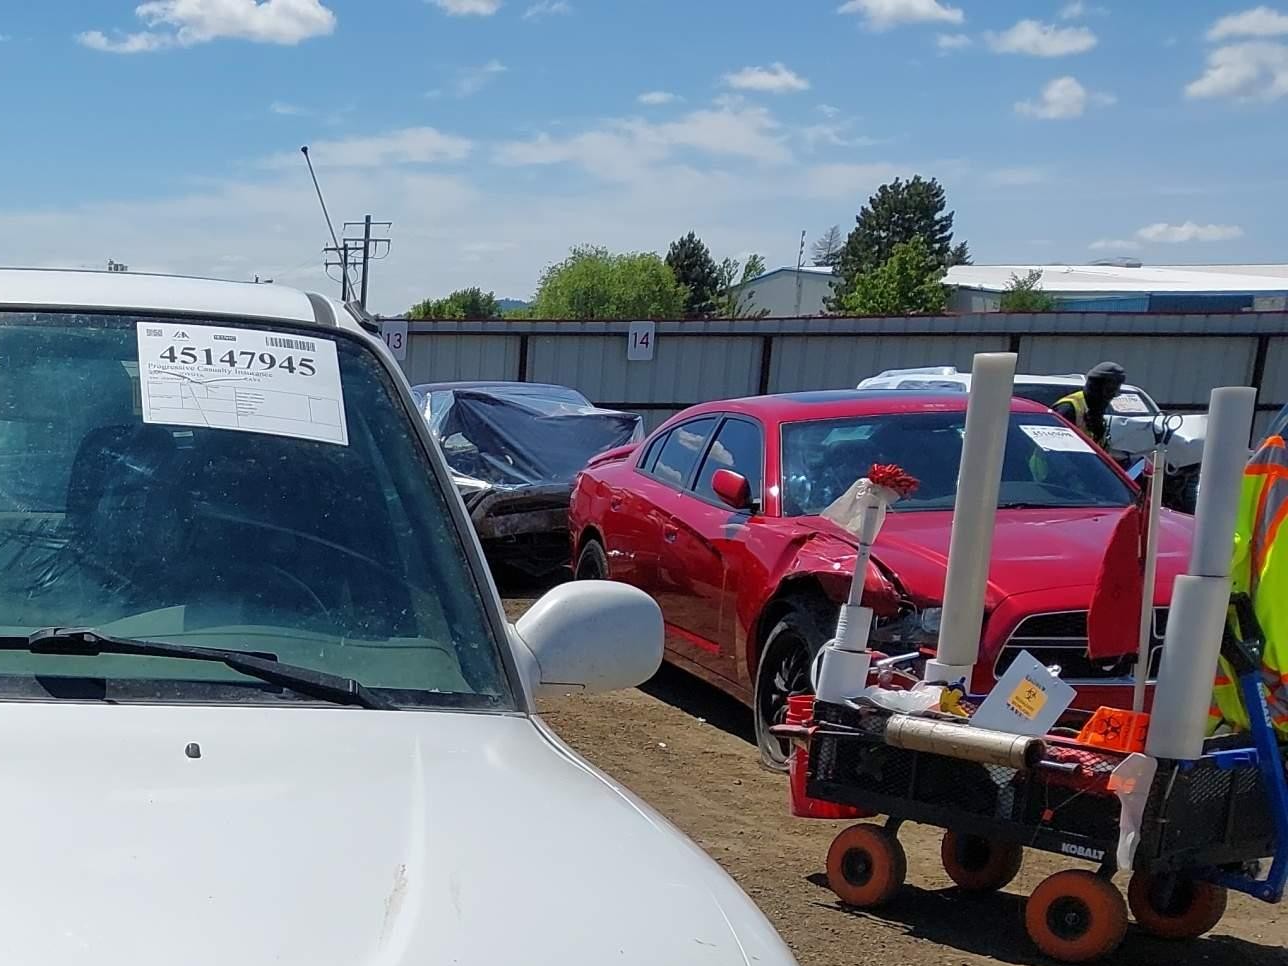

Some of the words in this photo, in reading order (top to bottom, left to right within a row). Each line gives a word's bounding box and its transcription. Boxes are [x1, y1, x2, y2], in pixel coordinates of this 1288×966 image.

[386, 333, 402, 349] 13
[632, 331, 649, 349] 14
[159, 344, 317, 377] 45147945
[148, 362, 196, 373] Progressive
[197, 365, 232, 376] Casualty
[235, 368, 273, 379] Insurance
[1256, 682, 1273, 729] KOBALT
[1061, 842, 1105, 860] KOBALT
